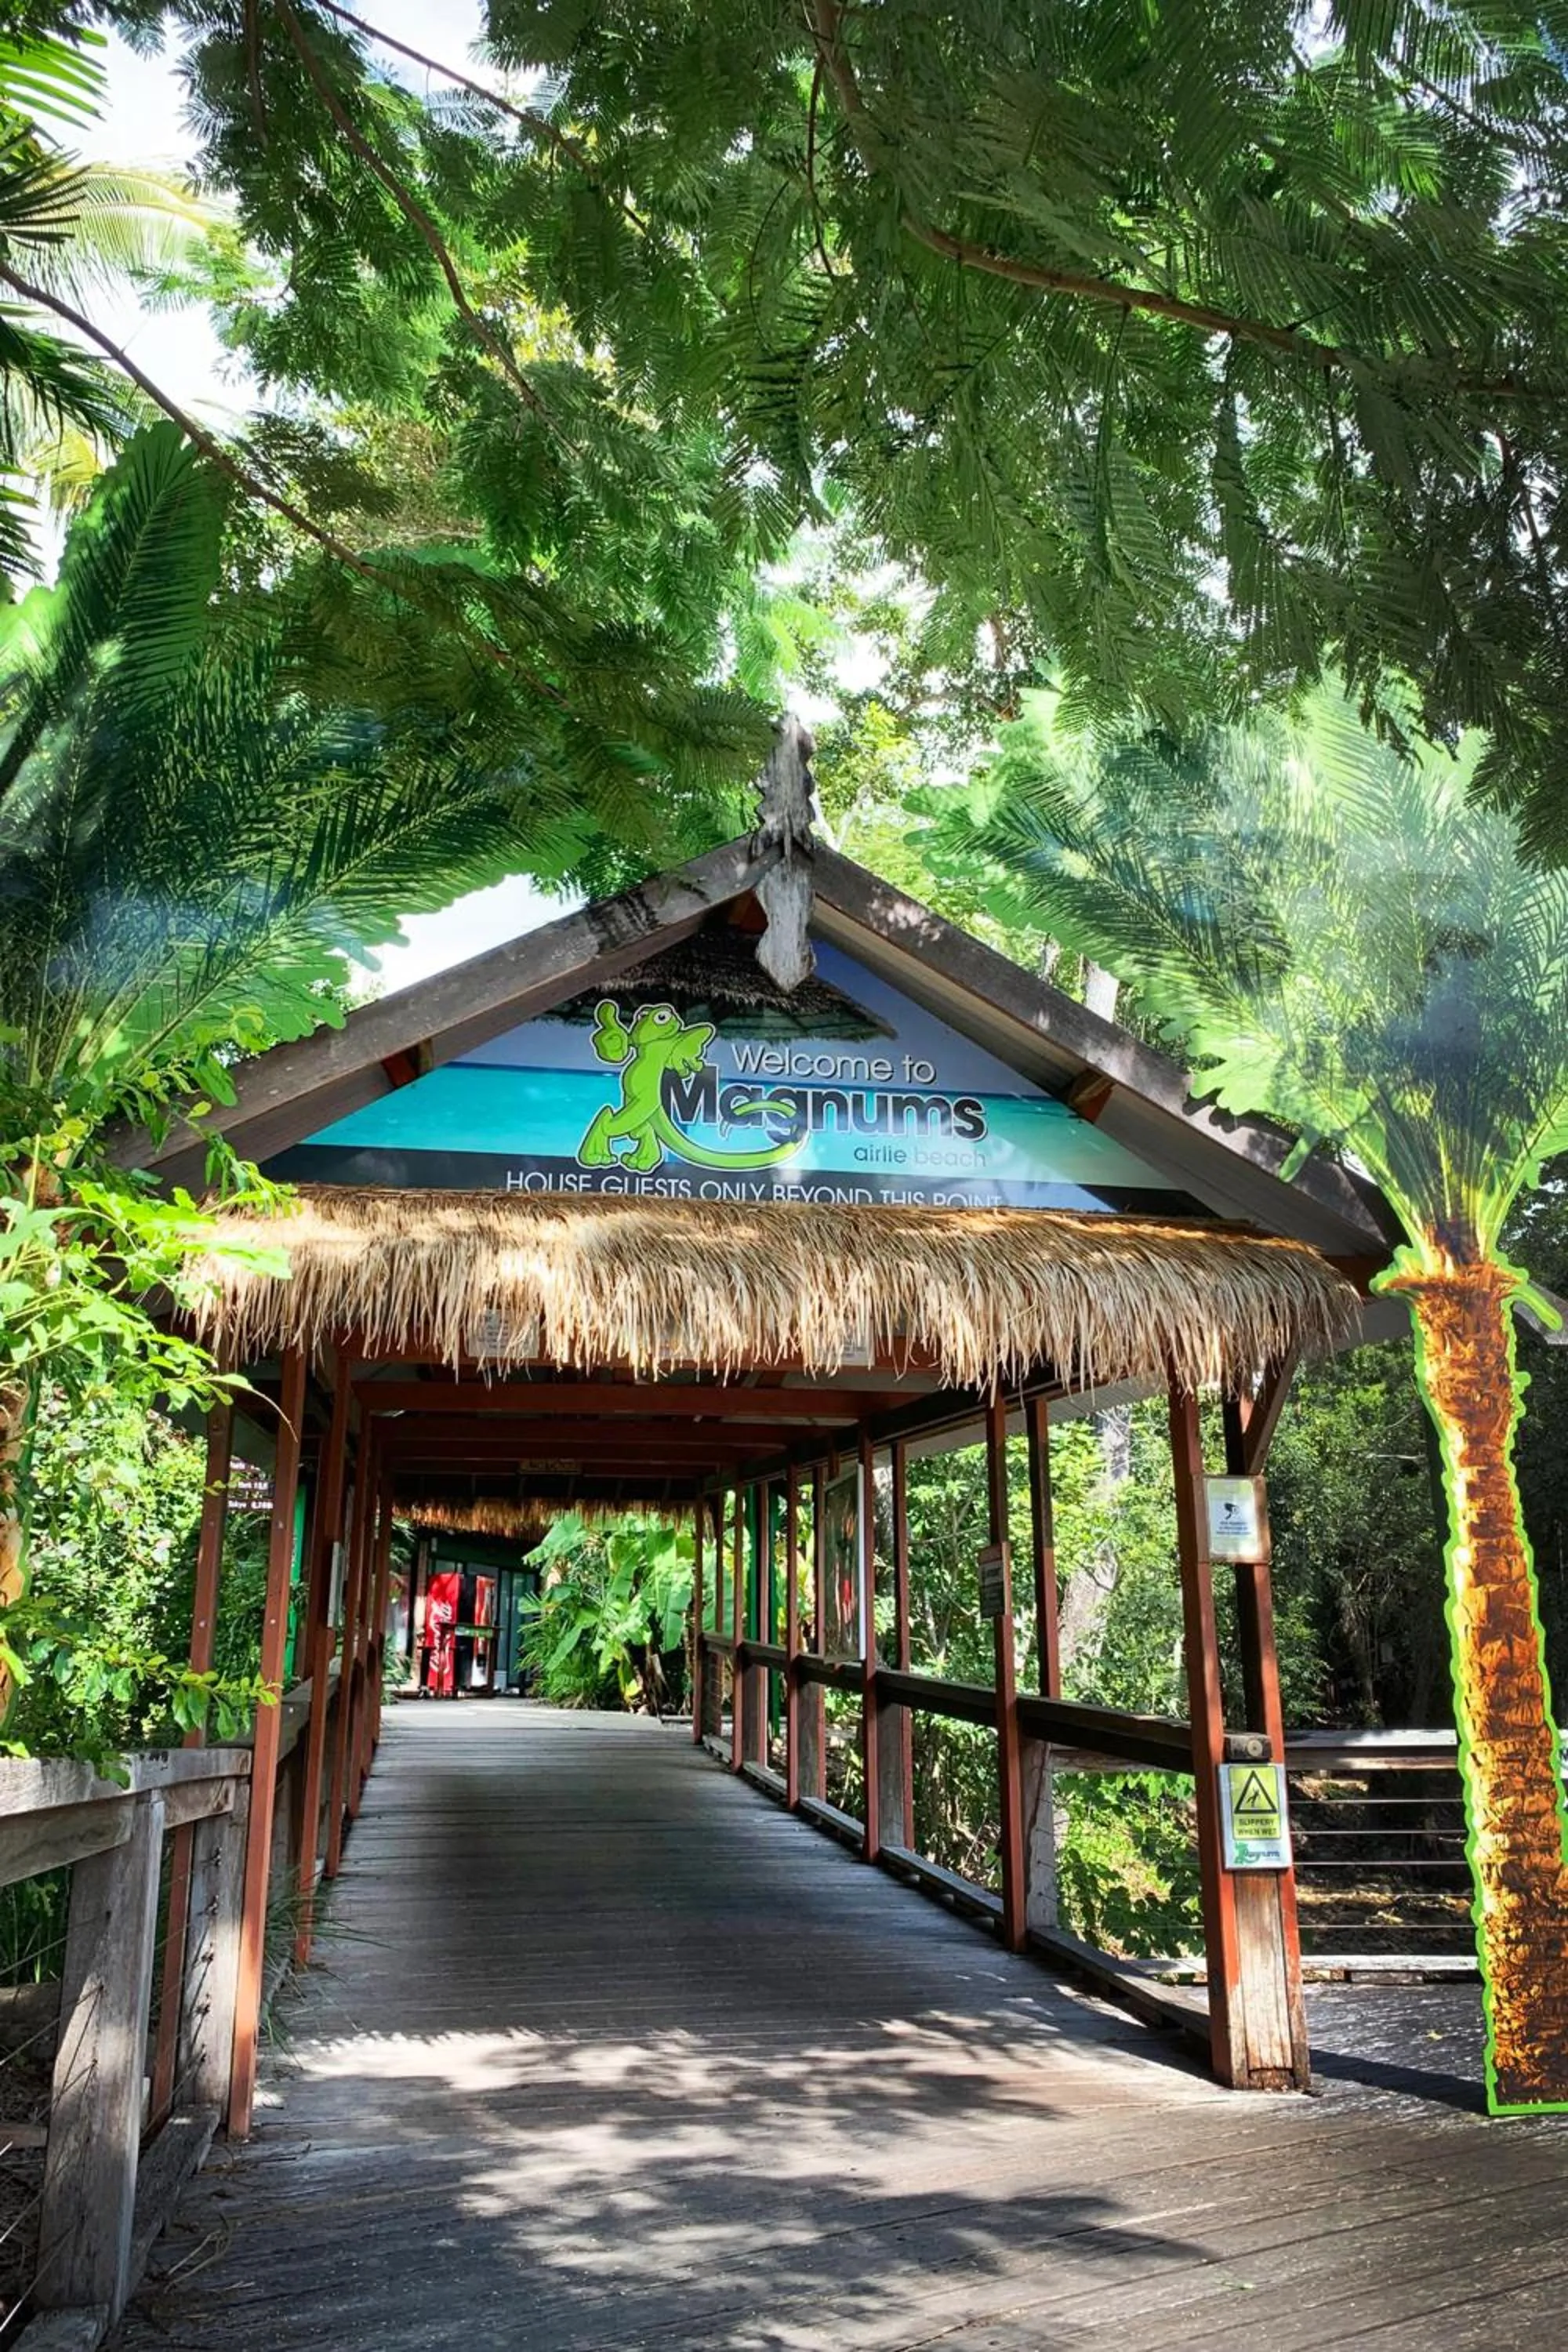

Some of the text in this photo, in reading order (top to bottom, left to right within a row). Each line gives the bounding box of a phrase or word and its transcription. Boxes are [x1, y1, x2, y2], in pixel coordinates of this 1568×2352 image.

[731, 1043, 937, 1084] Welcome to
[660, 1062, 988, 1145] Magnums
[854, 1144, 987, 1168] airlie beach
[506, 1171, 592, 1192] HOUSE
[601, 1176, 691, 1199] GUESTS
[699, 1181, 766, 1202] ONLY
